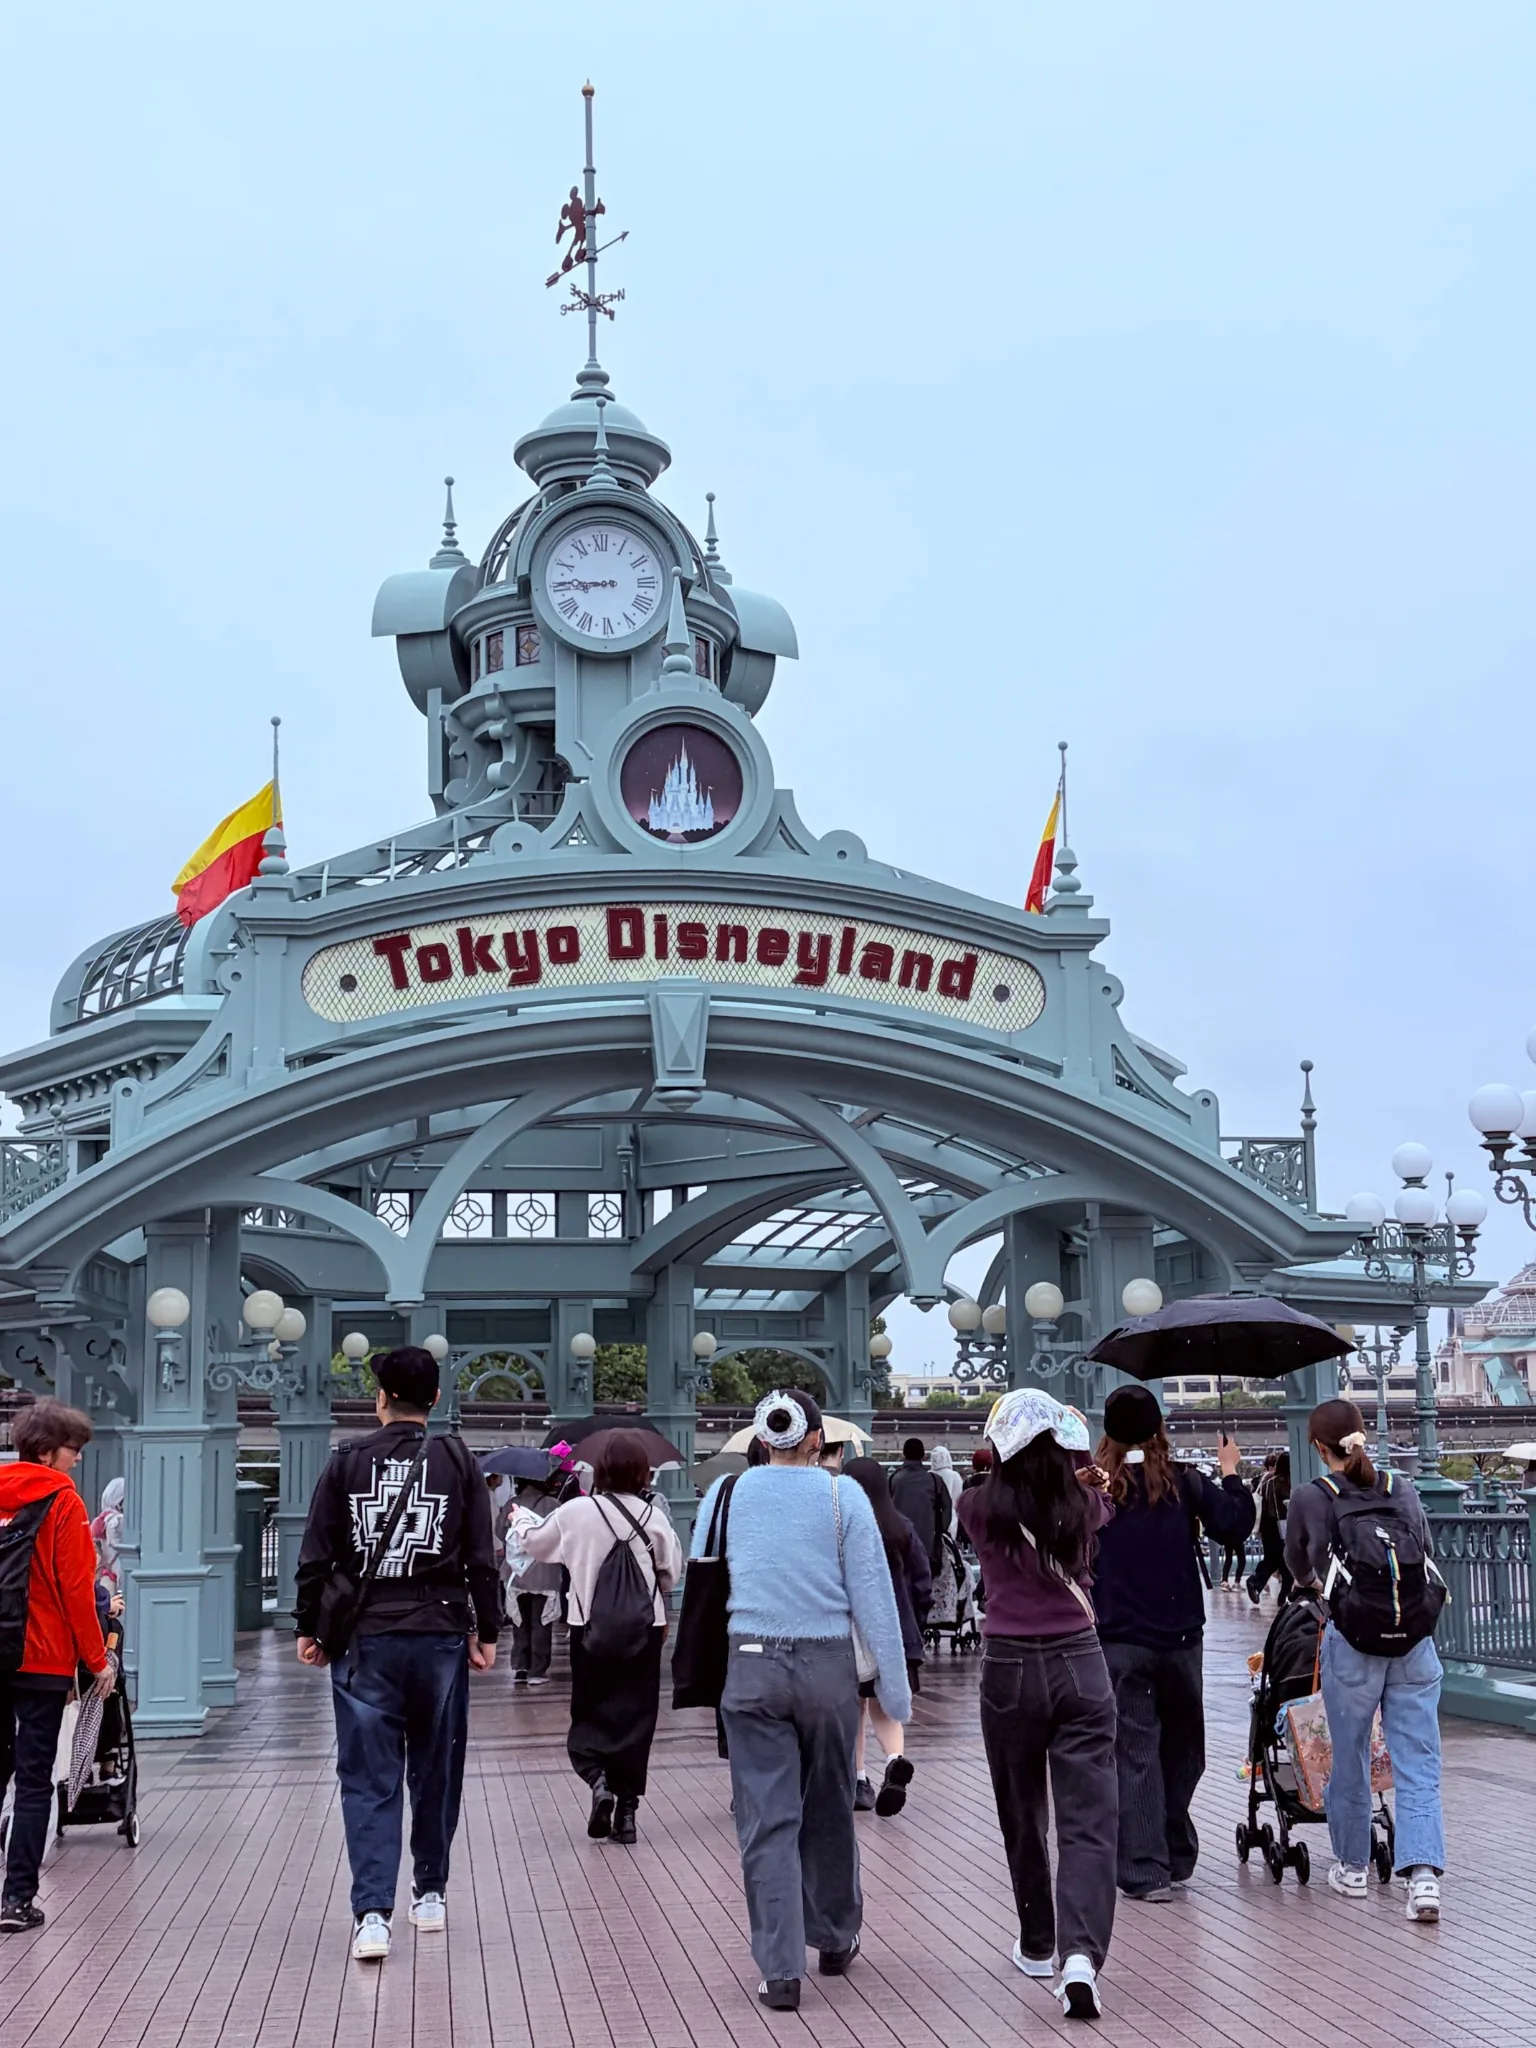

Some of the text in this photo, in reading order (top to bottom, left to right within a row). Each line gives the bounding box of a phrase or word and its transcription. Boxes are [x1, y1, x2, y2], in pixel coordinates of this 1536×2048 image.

[571, 539, 588, 558] XI
[592, 534, 608, 552] XII
[556, 559, 575, 573] X
[630, 555, 648, 569] II
[637, 576, 656, 589] III
[373, 907, 978, 1000] Tokyo Disneyland
